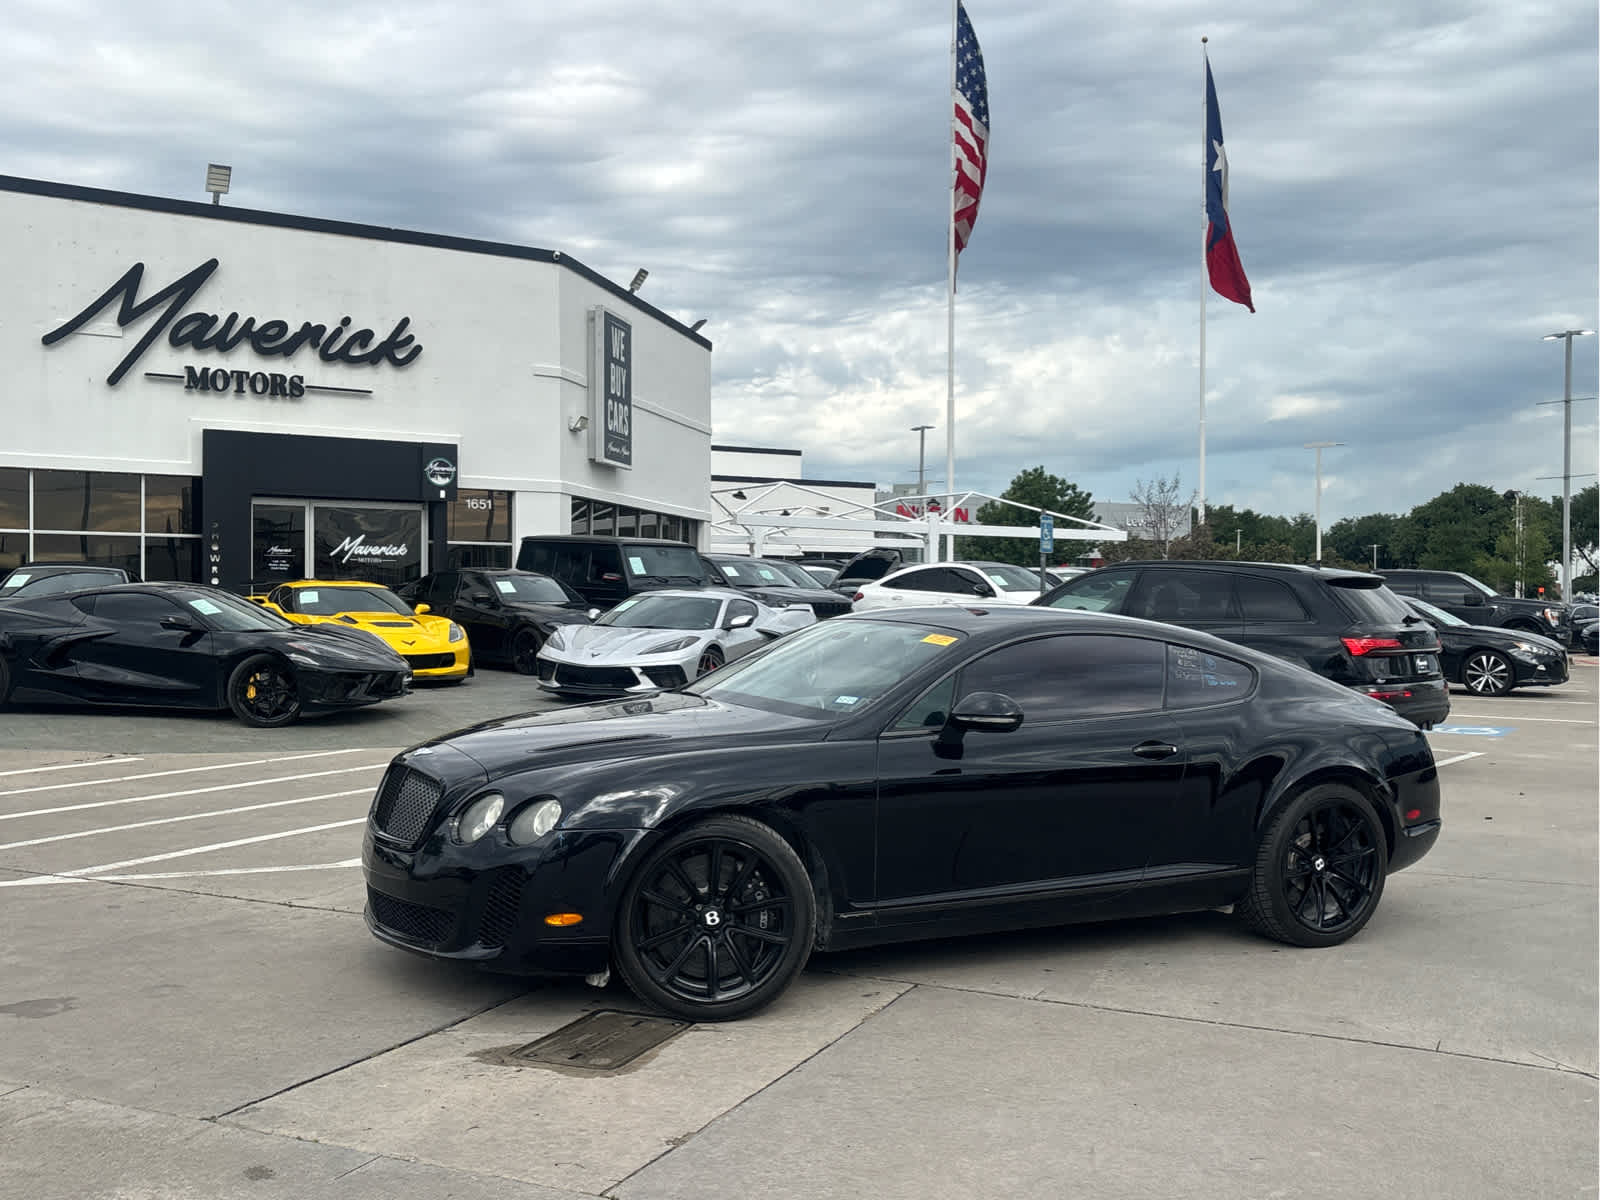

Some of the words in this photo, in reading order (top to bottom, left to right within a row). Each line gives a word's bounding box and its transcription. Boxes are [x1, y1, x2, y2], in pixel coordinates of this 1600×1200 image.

[42, 258, 423, 386] Maverick
[611, 325, 626, 362] WE
[184, 366, 305, 398] MOTORS
[610, 362, 627, 400] BUY
[608, 398, 629, 436] CARS
[465, 498, 492, 510] 1651
[329, 534, 408, 564] Maverick
[705, 911, 720, 925] B
